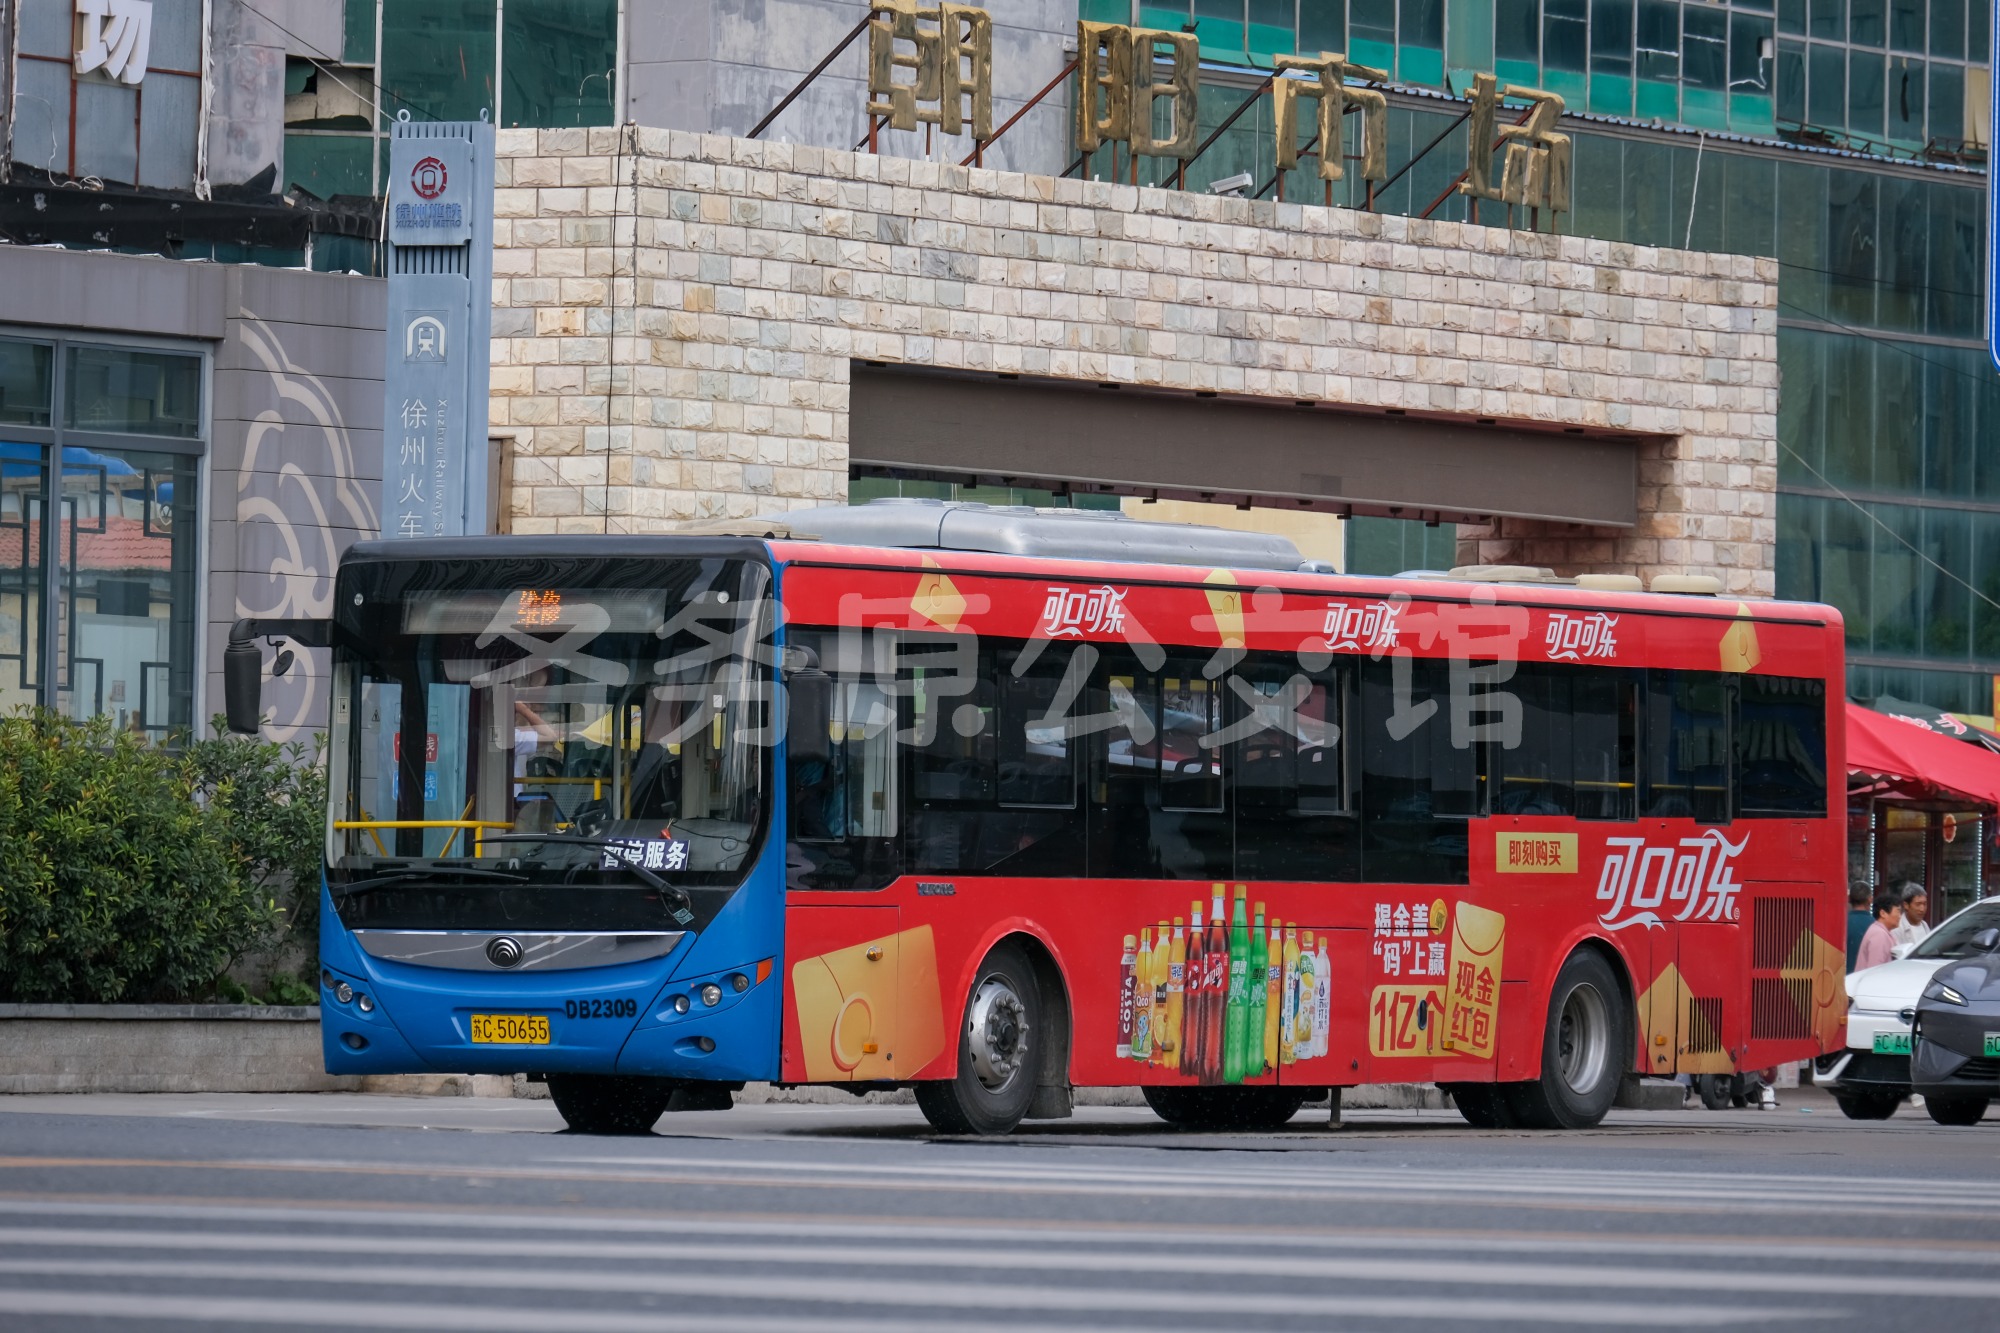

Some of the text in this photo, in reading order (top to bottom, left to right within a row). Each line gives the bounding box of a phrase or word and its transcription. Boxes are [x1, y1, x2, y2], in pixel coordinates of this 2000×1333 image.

[395, 219, 462, 229] XUZHOU METRO
[435, 399, 448, 455] Xuzhou
[431, 458, 446, 517] Railway
[1043, 584, 1129, 637] 可口可乐
[1323, 601, 1403, 651] 可口可乐
[1545, 612, 1620, 661] 可口可乐
[1508, 839, 1562, 867] 即刻购买
[1596, 828, 1751, 932] 可口可乐
[1373, 902, 1429, 938] 揭金盖
[1122, 976, 1133, 1034] COSTA
[1454, 959, 1496, 1008] 现金
[565, 999, 638, 1020] DB2309
[1450, 1001, 1491, 1051] 红包
